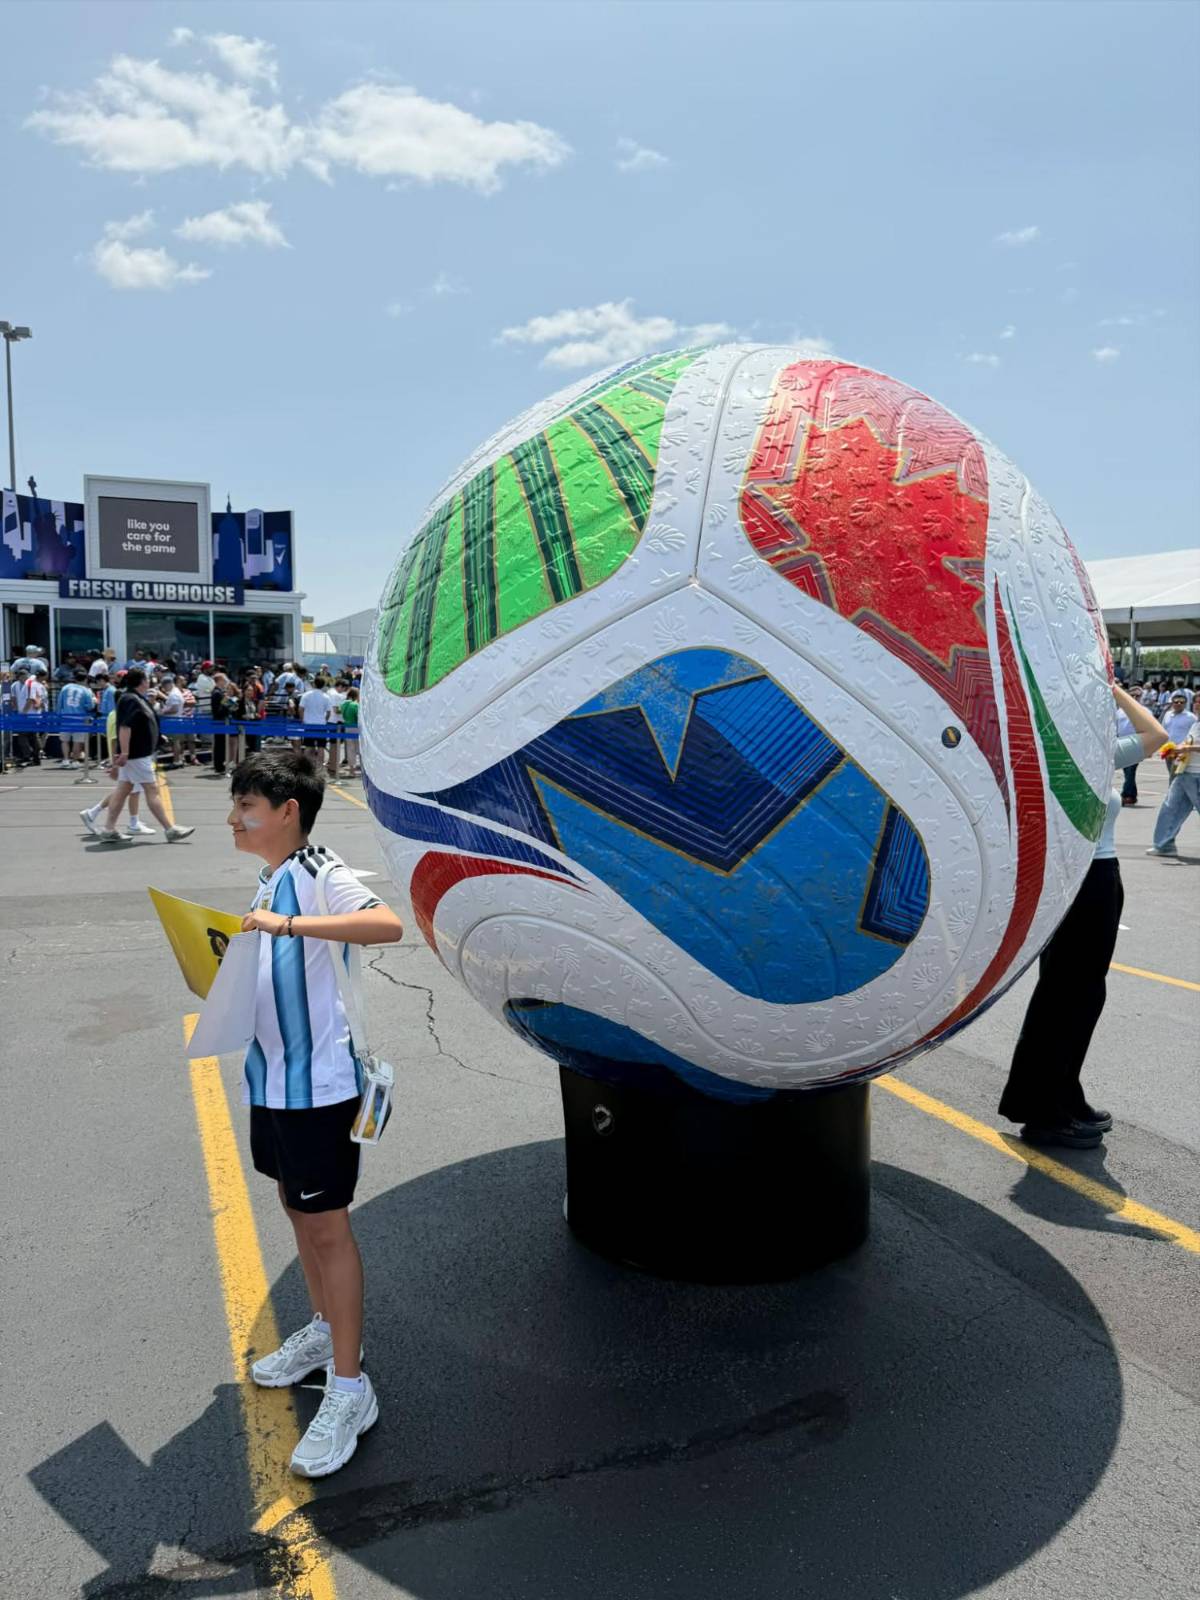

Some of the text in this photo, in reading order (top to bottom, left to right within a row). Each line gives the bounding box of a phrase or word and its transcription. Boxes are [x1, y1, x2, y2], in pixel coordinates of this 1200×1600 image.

[127, 518, 170, 532] like you
[127, 531, 172, 542] care for
[122, 541, 176, 554] the game
[68, 579, 236, 604] FRESH CLUBHOUSE
